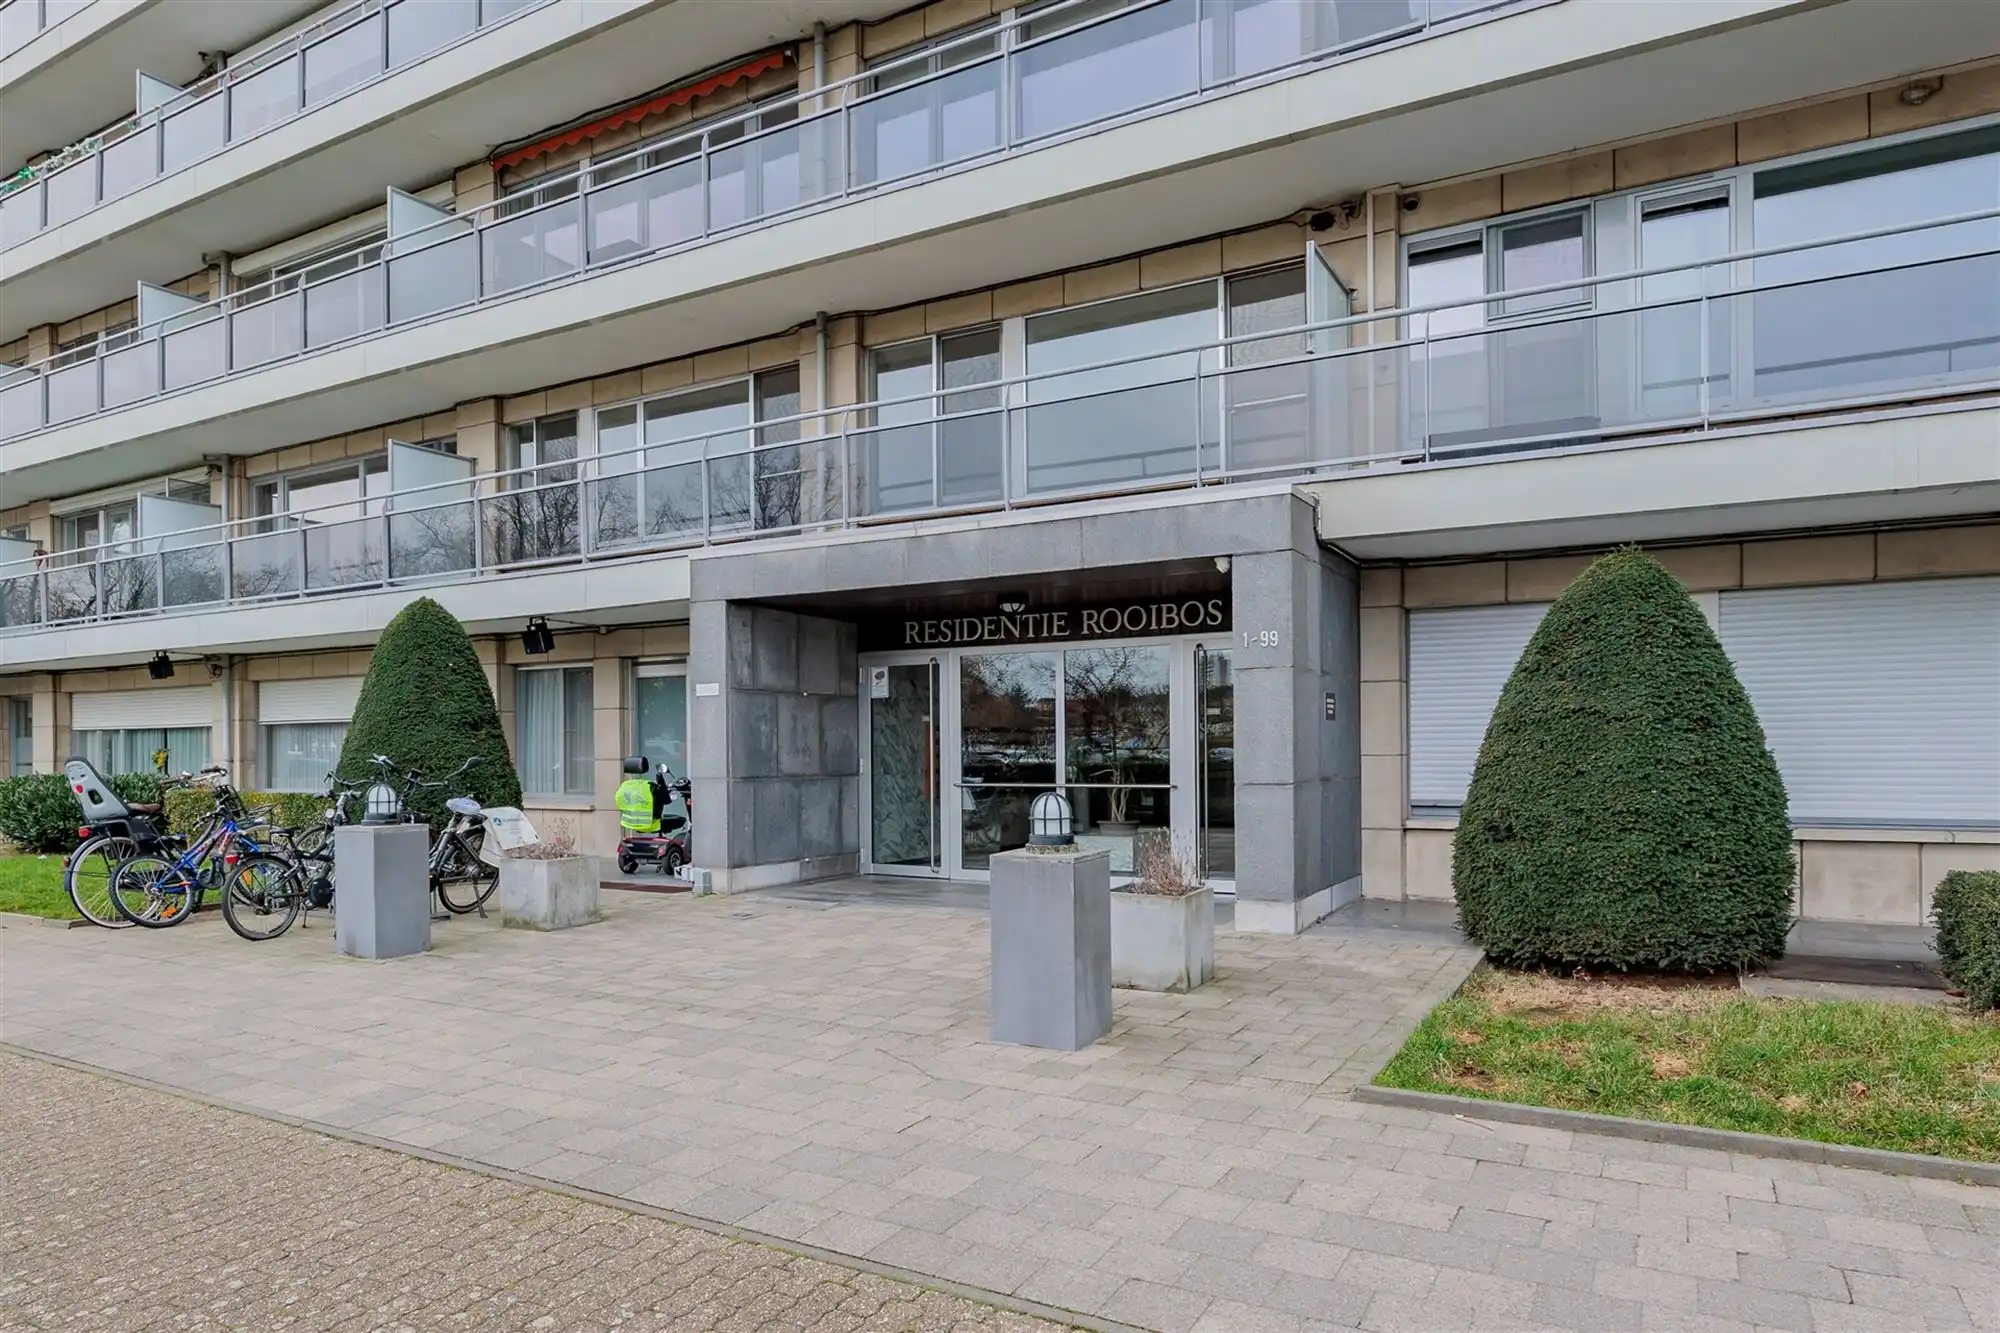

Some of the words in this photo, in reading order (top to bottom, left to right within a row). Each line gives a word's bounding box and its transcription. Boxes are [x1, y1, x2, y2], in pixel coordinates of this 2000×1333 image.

[904, 612, 1070, 644] RESIDENTIE
[1081, 599, 1223, 634] ROOIBOS
[1242, 630, 1279, 648] 1-99
